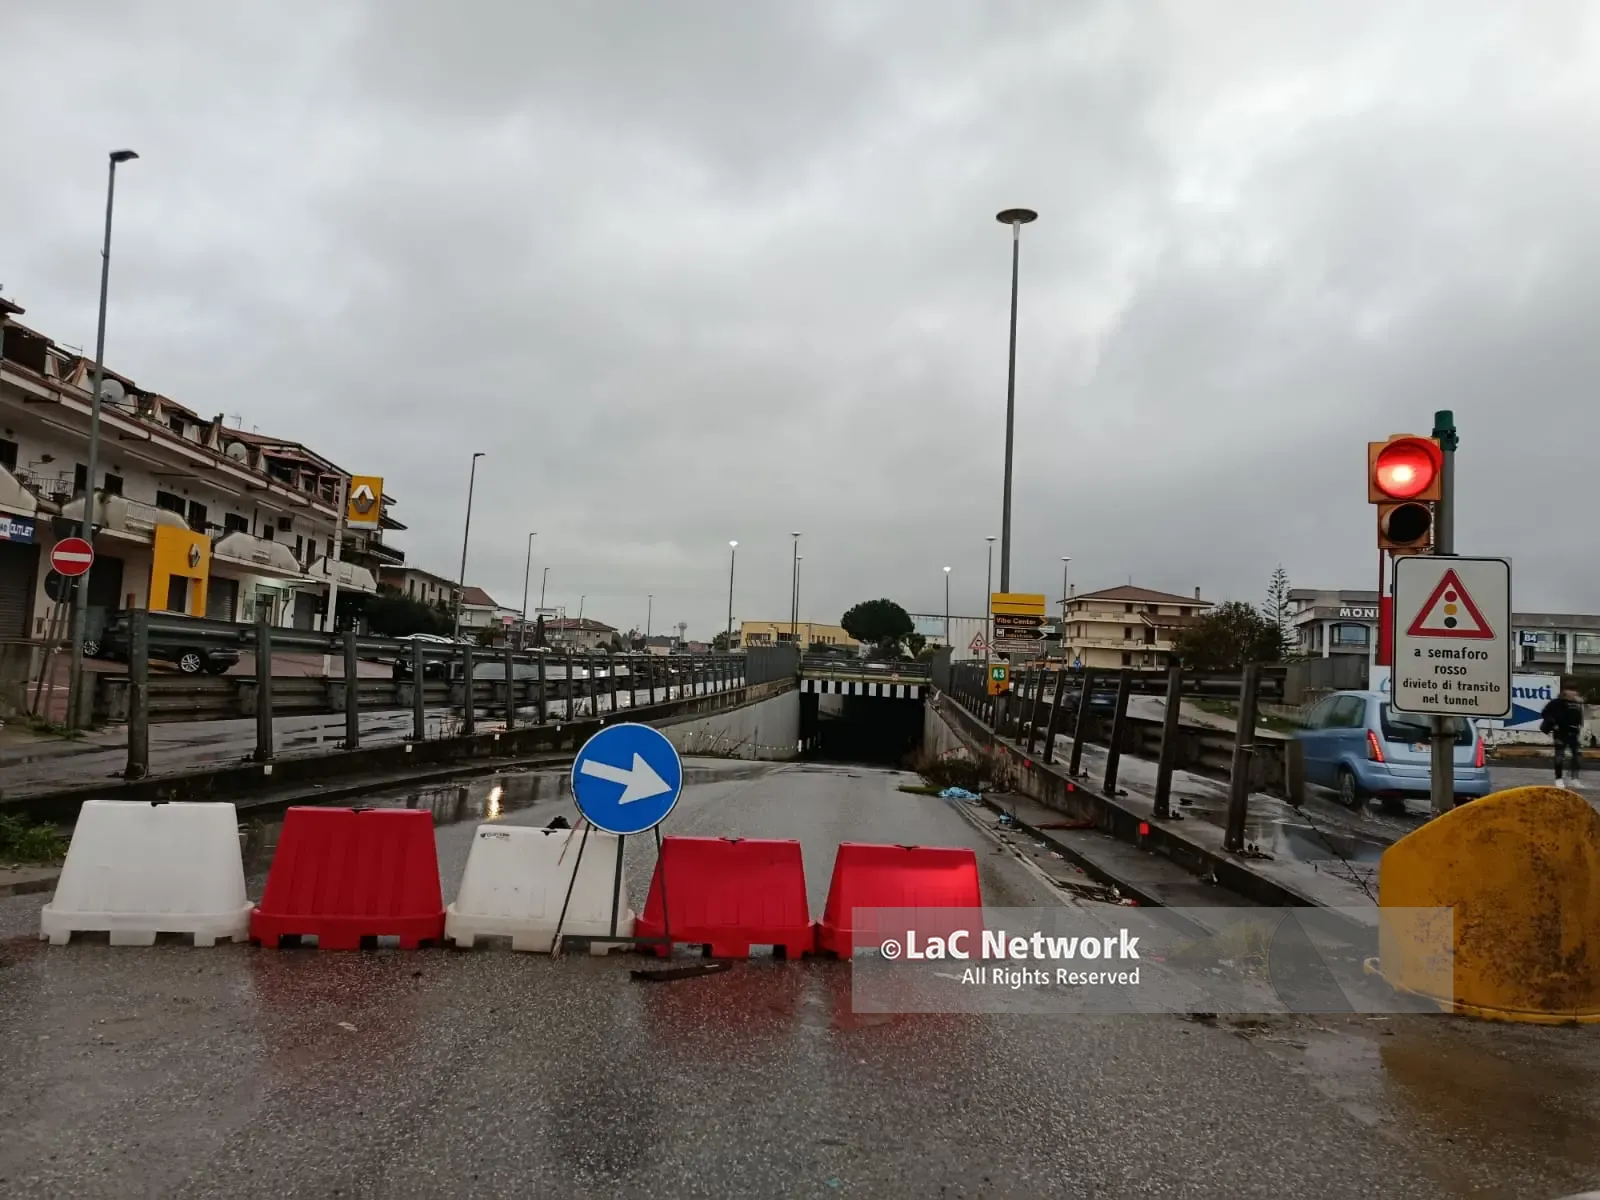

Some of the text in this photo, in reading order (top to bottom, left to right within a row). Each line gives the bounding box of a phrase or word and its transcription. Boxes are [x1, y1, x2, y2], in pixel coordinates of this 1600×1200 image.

[1414, 647, 1488, 660] a semaforo
[992, 669, 1005, 679] A3
[1434, 665, 1467, 675] rosso
[1403, 678, 1500, 692] divieto di transito
[1422, 694, 1479, 706] nel tunnel
